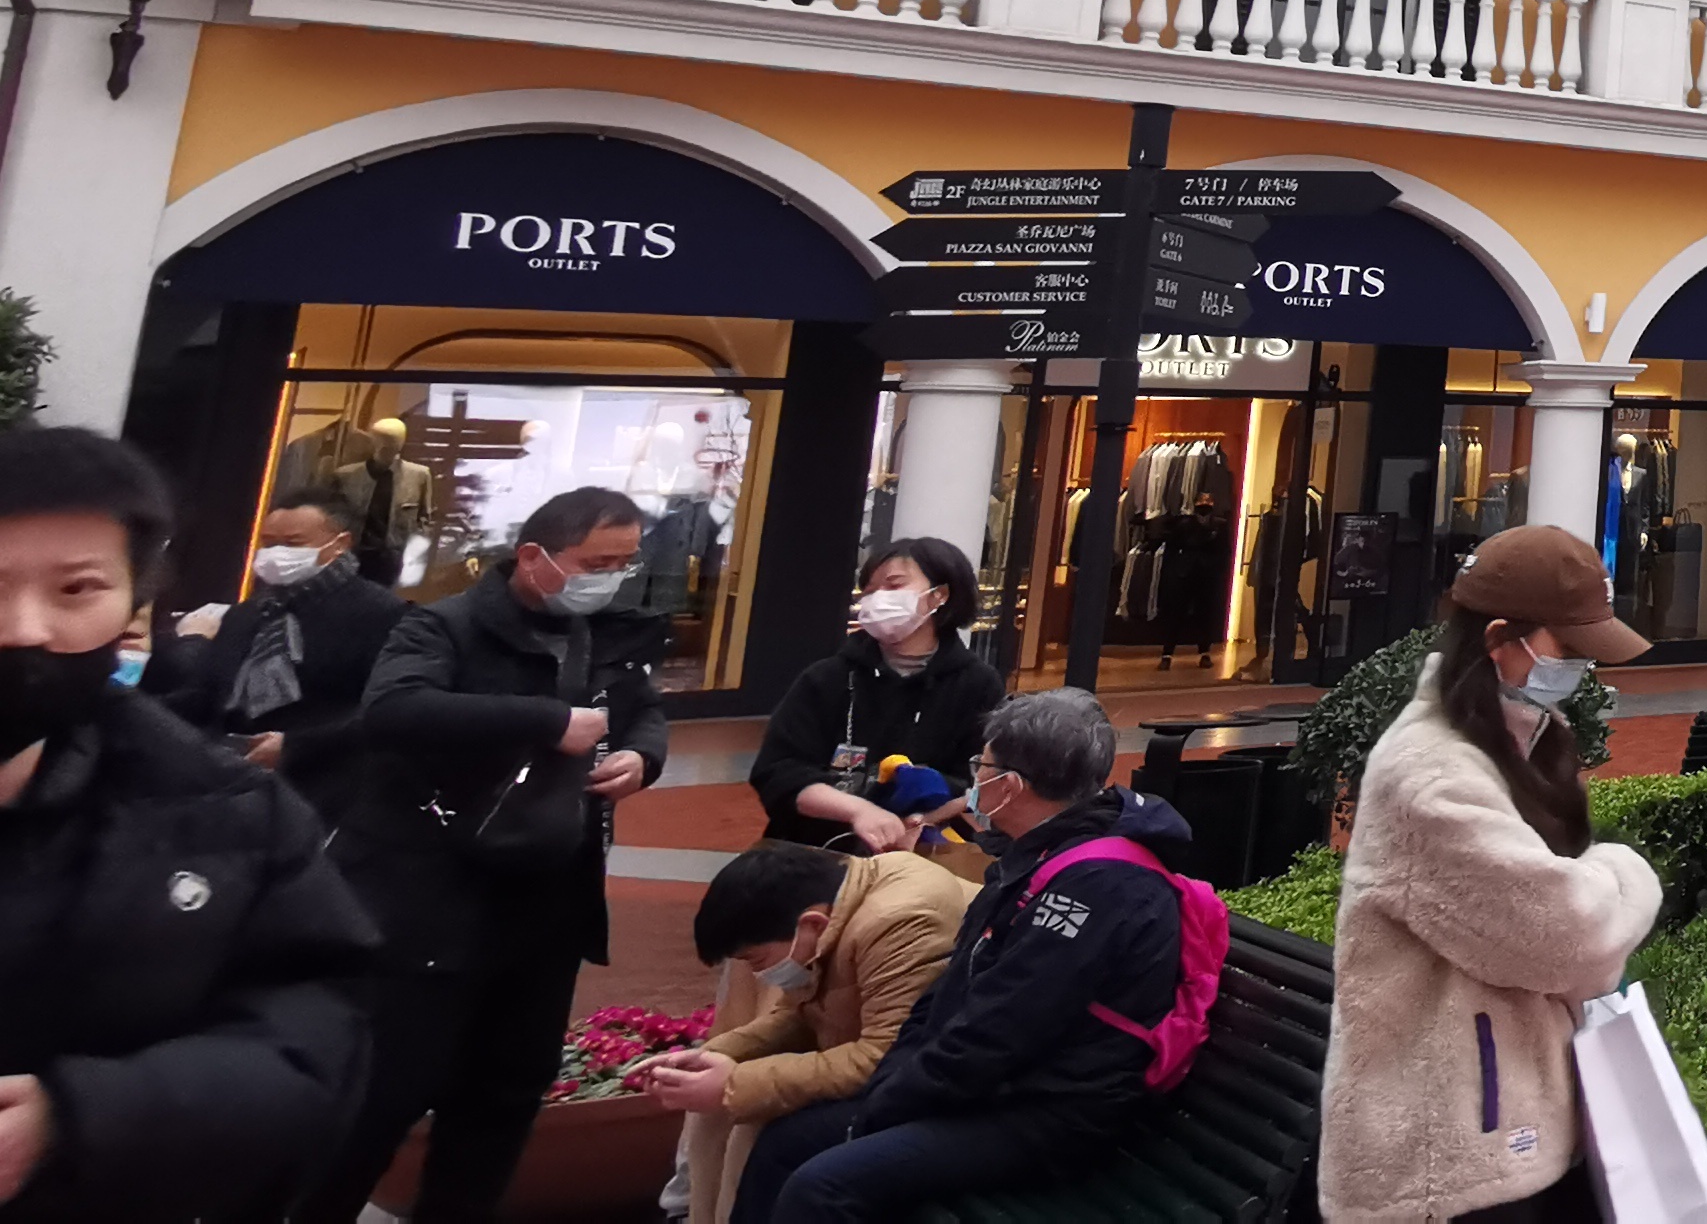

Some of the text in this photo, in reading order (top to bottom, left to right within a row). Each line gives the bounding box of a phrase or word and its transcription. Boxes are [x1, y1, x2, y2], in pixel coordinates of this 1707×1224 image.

[1184, 177, 1228, 191] 7号门
[1258, 177, 1300, 192] 停车场
[946, 186, 966, 199] 2F
[966, 195, 1101, 208] JUNGLE ENTERTAINMENT
[1180, 195, 1215, 206] GATE
[1237, 195, 1297, 207] PARKING
[455, 212, 677, 259] PORTS
[945, 243, 1093, 254] PIAZZA SAN GIOVANNI
[527, 258, 601, 271] OUTLET
[1035, 273, 1090, 288] 客服中心
[1235, 261, 1385, 298] ORTS
[957, 292, 1087, 302] CUSTOMER SERVICE
[1283, 295, 1333, 307] OUTLET
